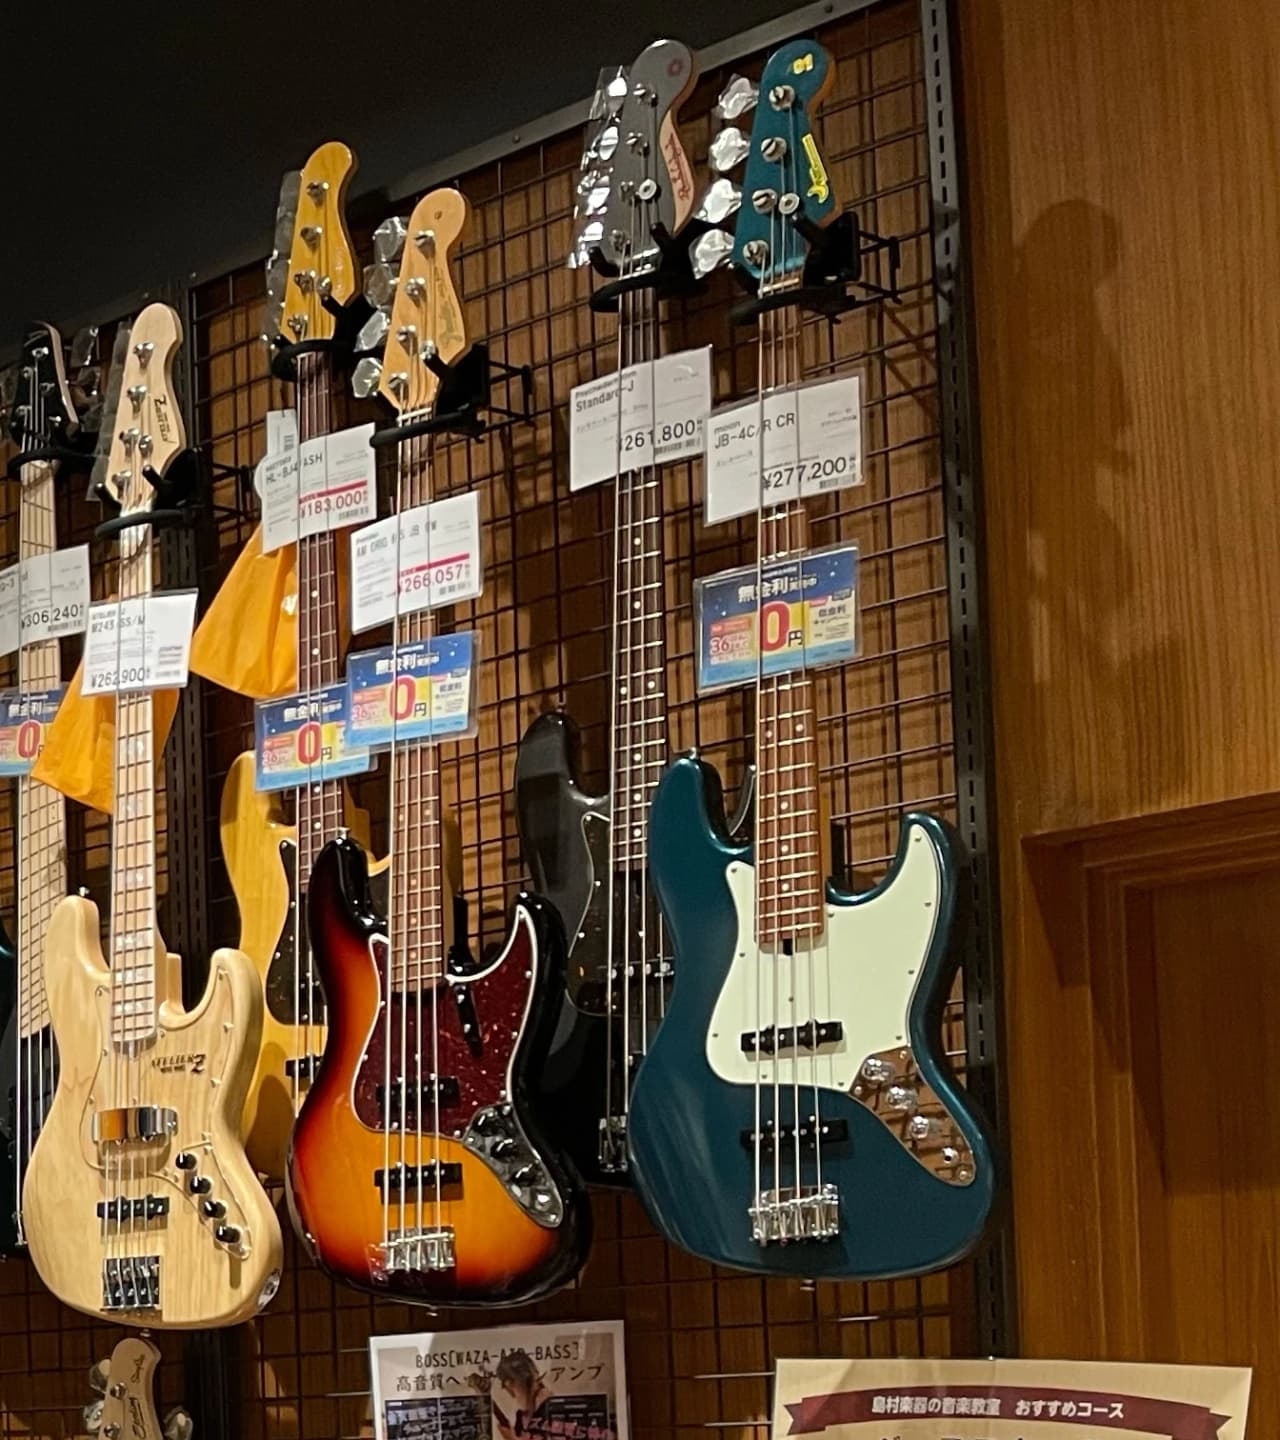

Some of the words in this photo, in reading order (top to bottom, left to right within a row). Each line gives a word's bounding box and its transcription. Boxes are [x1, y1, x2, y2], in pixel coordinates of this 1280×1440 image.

[1015, 1399, 1124, 1420] おすすめコース
